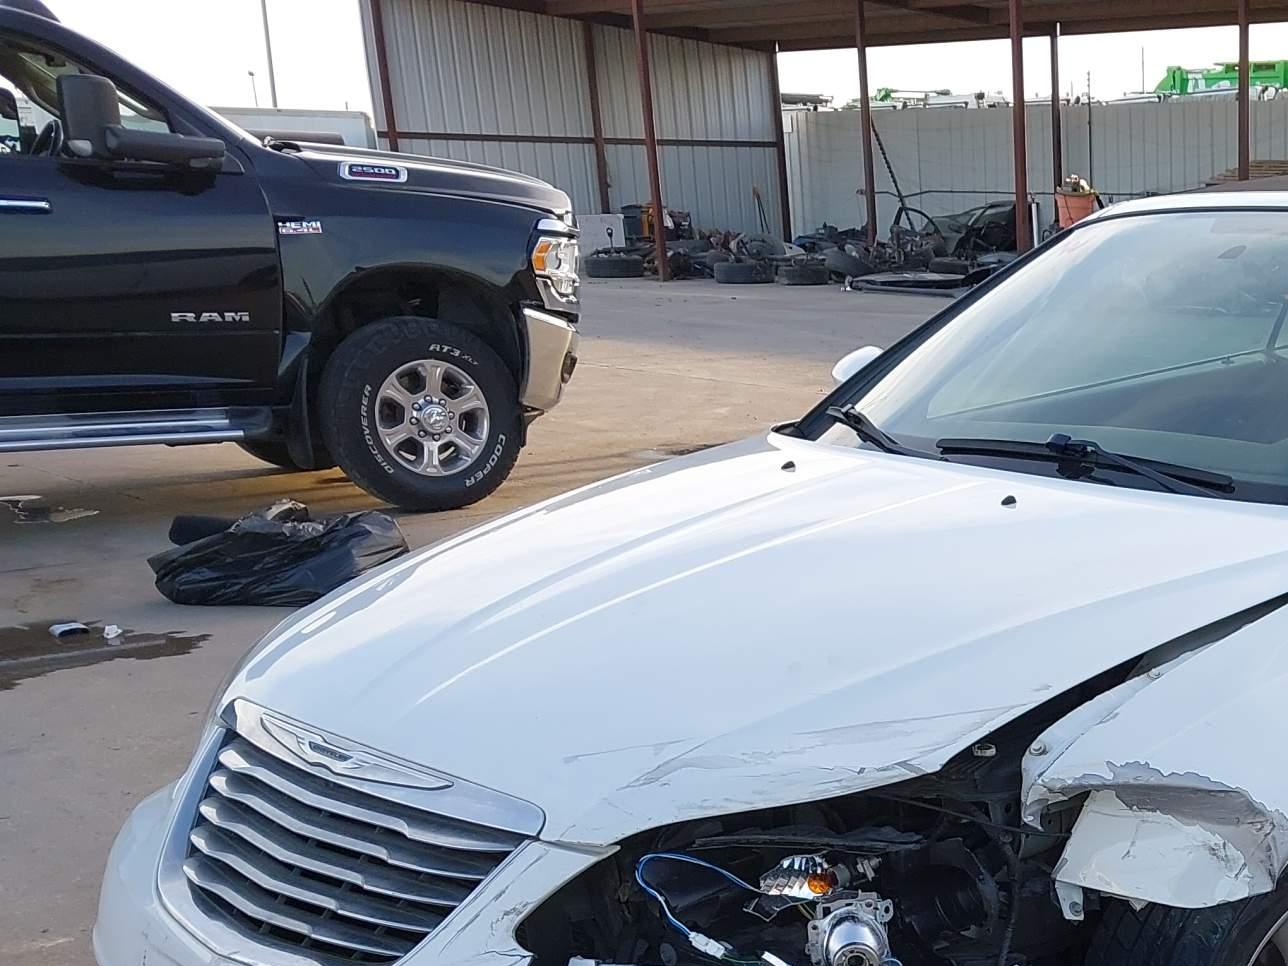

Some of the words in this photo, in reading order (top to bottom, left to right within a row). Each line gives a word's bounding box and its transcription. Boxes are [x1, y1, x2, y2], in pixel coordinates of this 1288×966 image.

[351, 166, 397, 175] 2500
[278, 221, 321, 229] HEMI
[170, 312, 249, 322] RAM
[428, 343, 461, 357] AT3
[360, 384, 395, 474] DISCOVERER
[464, 434, 506, 487] COOPER
